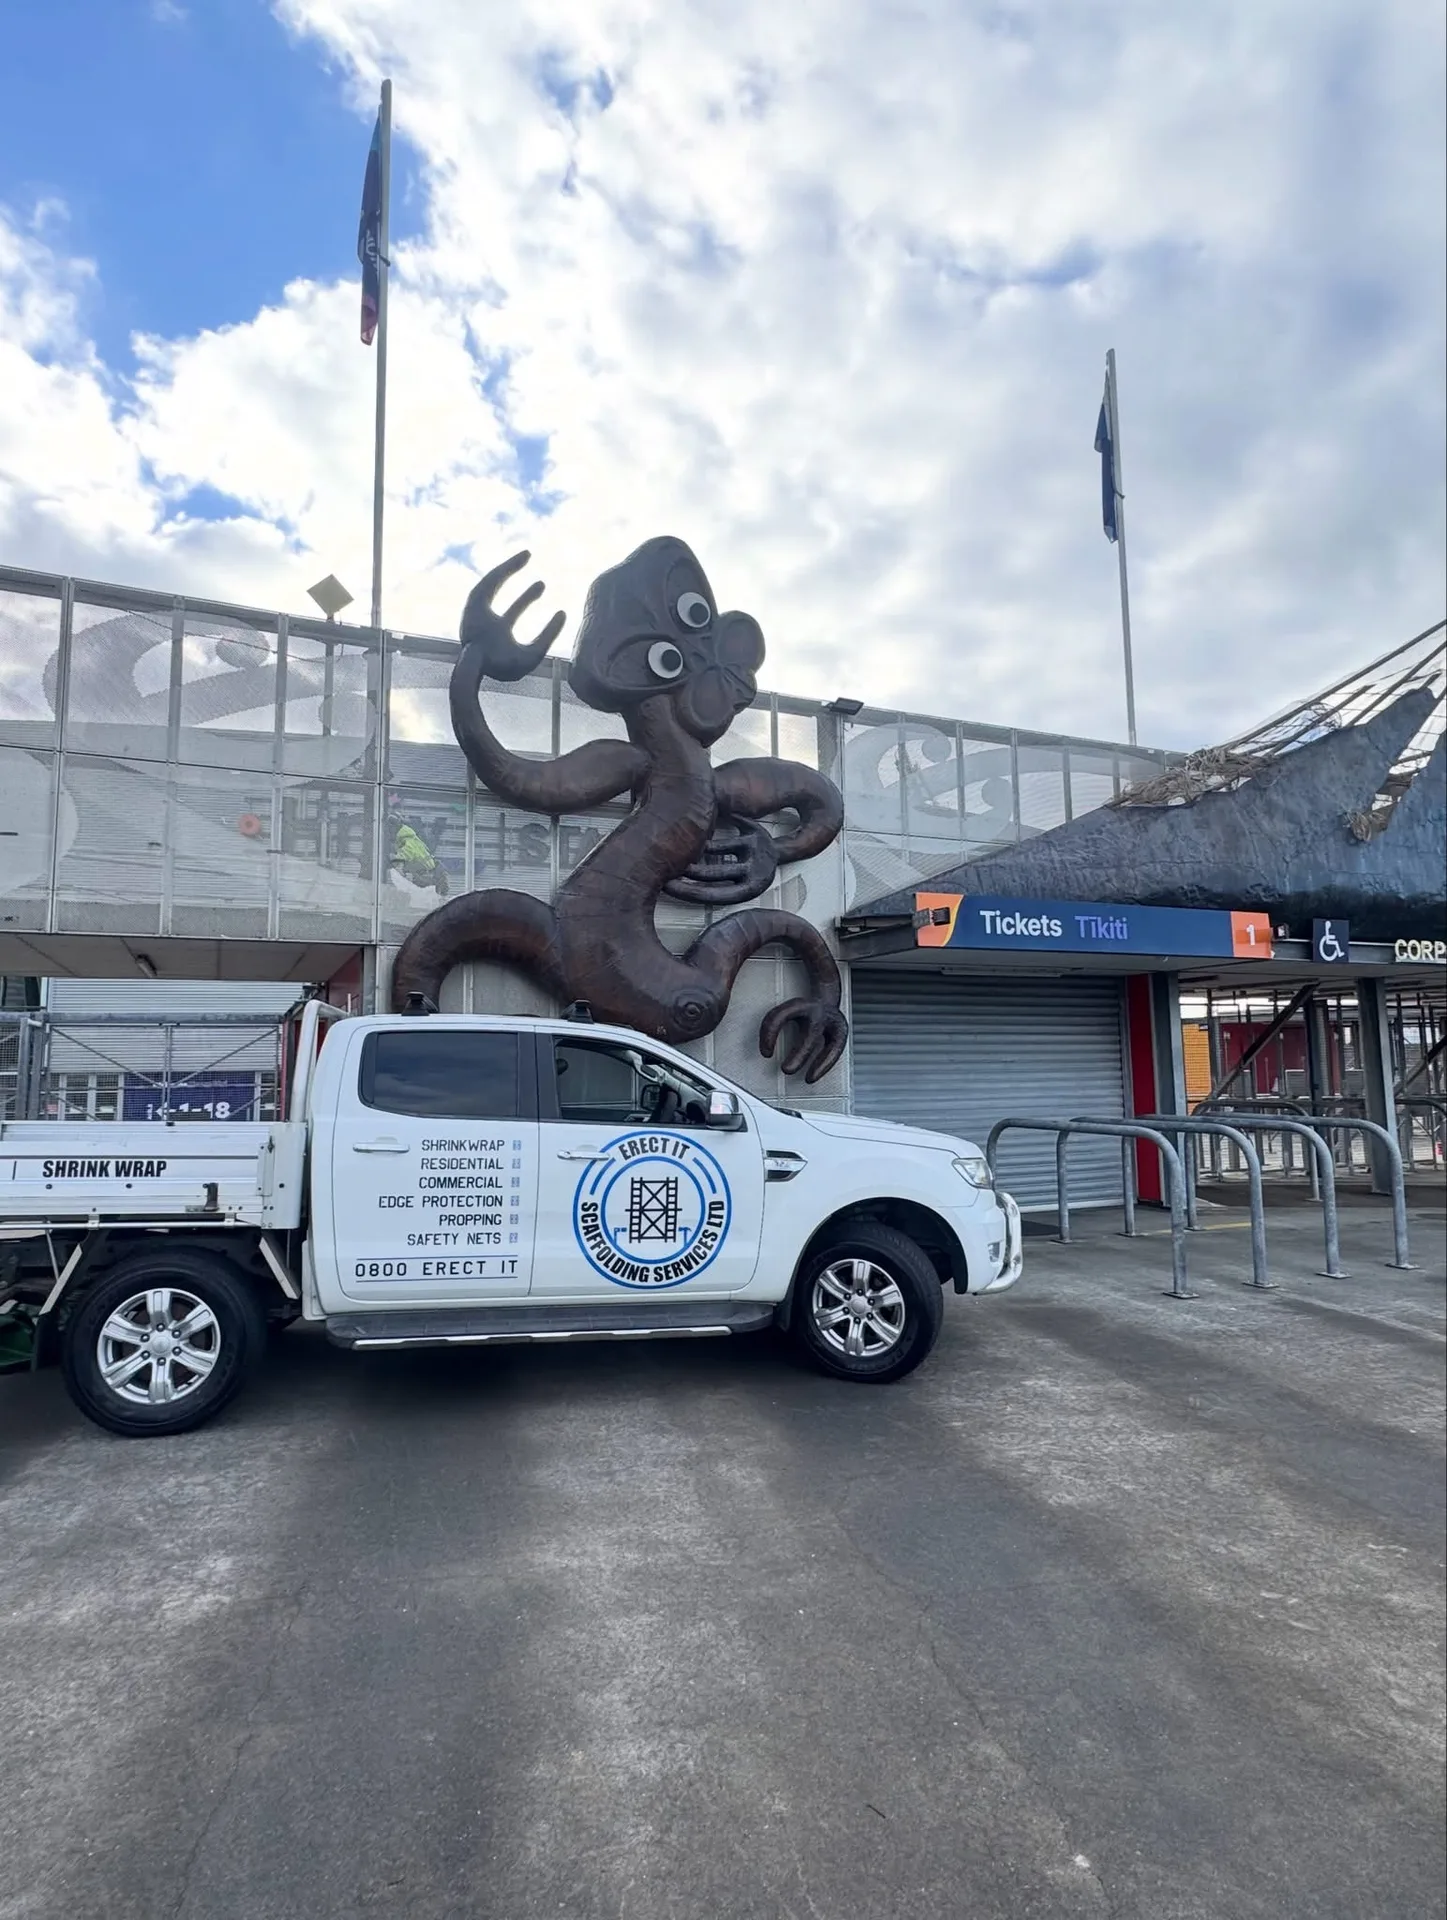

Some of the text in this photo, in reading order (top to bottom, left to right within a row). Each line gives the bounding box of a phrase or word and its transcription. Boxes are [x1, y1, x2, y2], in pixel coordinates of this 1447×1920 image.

[979, 910, 1128, 940] Tickets Tīkiti
[1245, 924, 1256, 946] 1
[1394, 938, 1446, 961] CORP
[421, 1139, 505, 1151] SHRINKWRAP
[618, 1136, 690, 1161] ERECT IT
[42, 1160, 167, 1178] SHRINK WRAP
[420, 1157, 504, 1170] RESIDENTIAL
[418, 1176, 504, 1189] COMMERCIAL
[378, 1195, 504, 1208] EDGE PROTECTION
[439, 1213, 502, 1226] PROPPING
[407, 1232, 502, 1246] SAFETY NETS
[580, 1200, 725, 1283] SCAFFOLDING SERVICES LTD
[355, 1259, 519, 1278] 0800 ERECT IT
